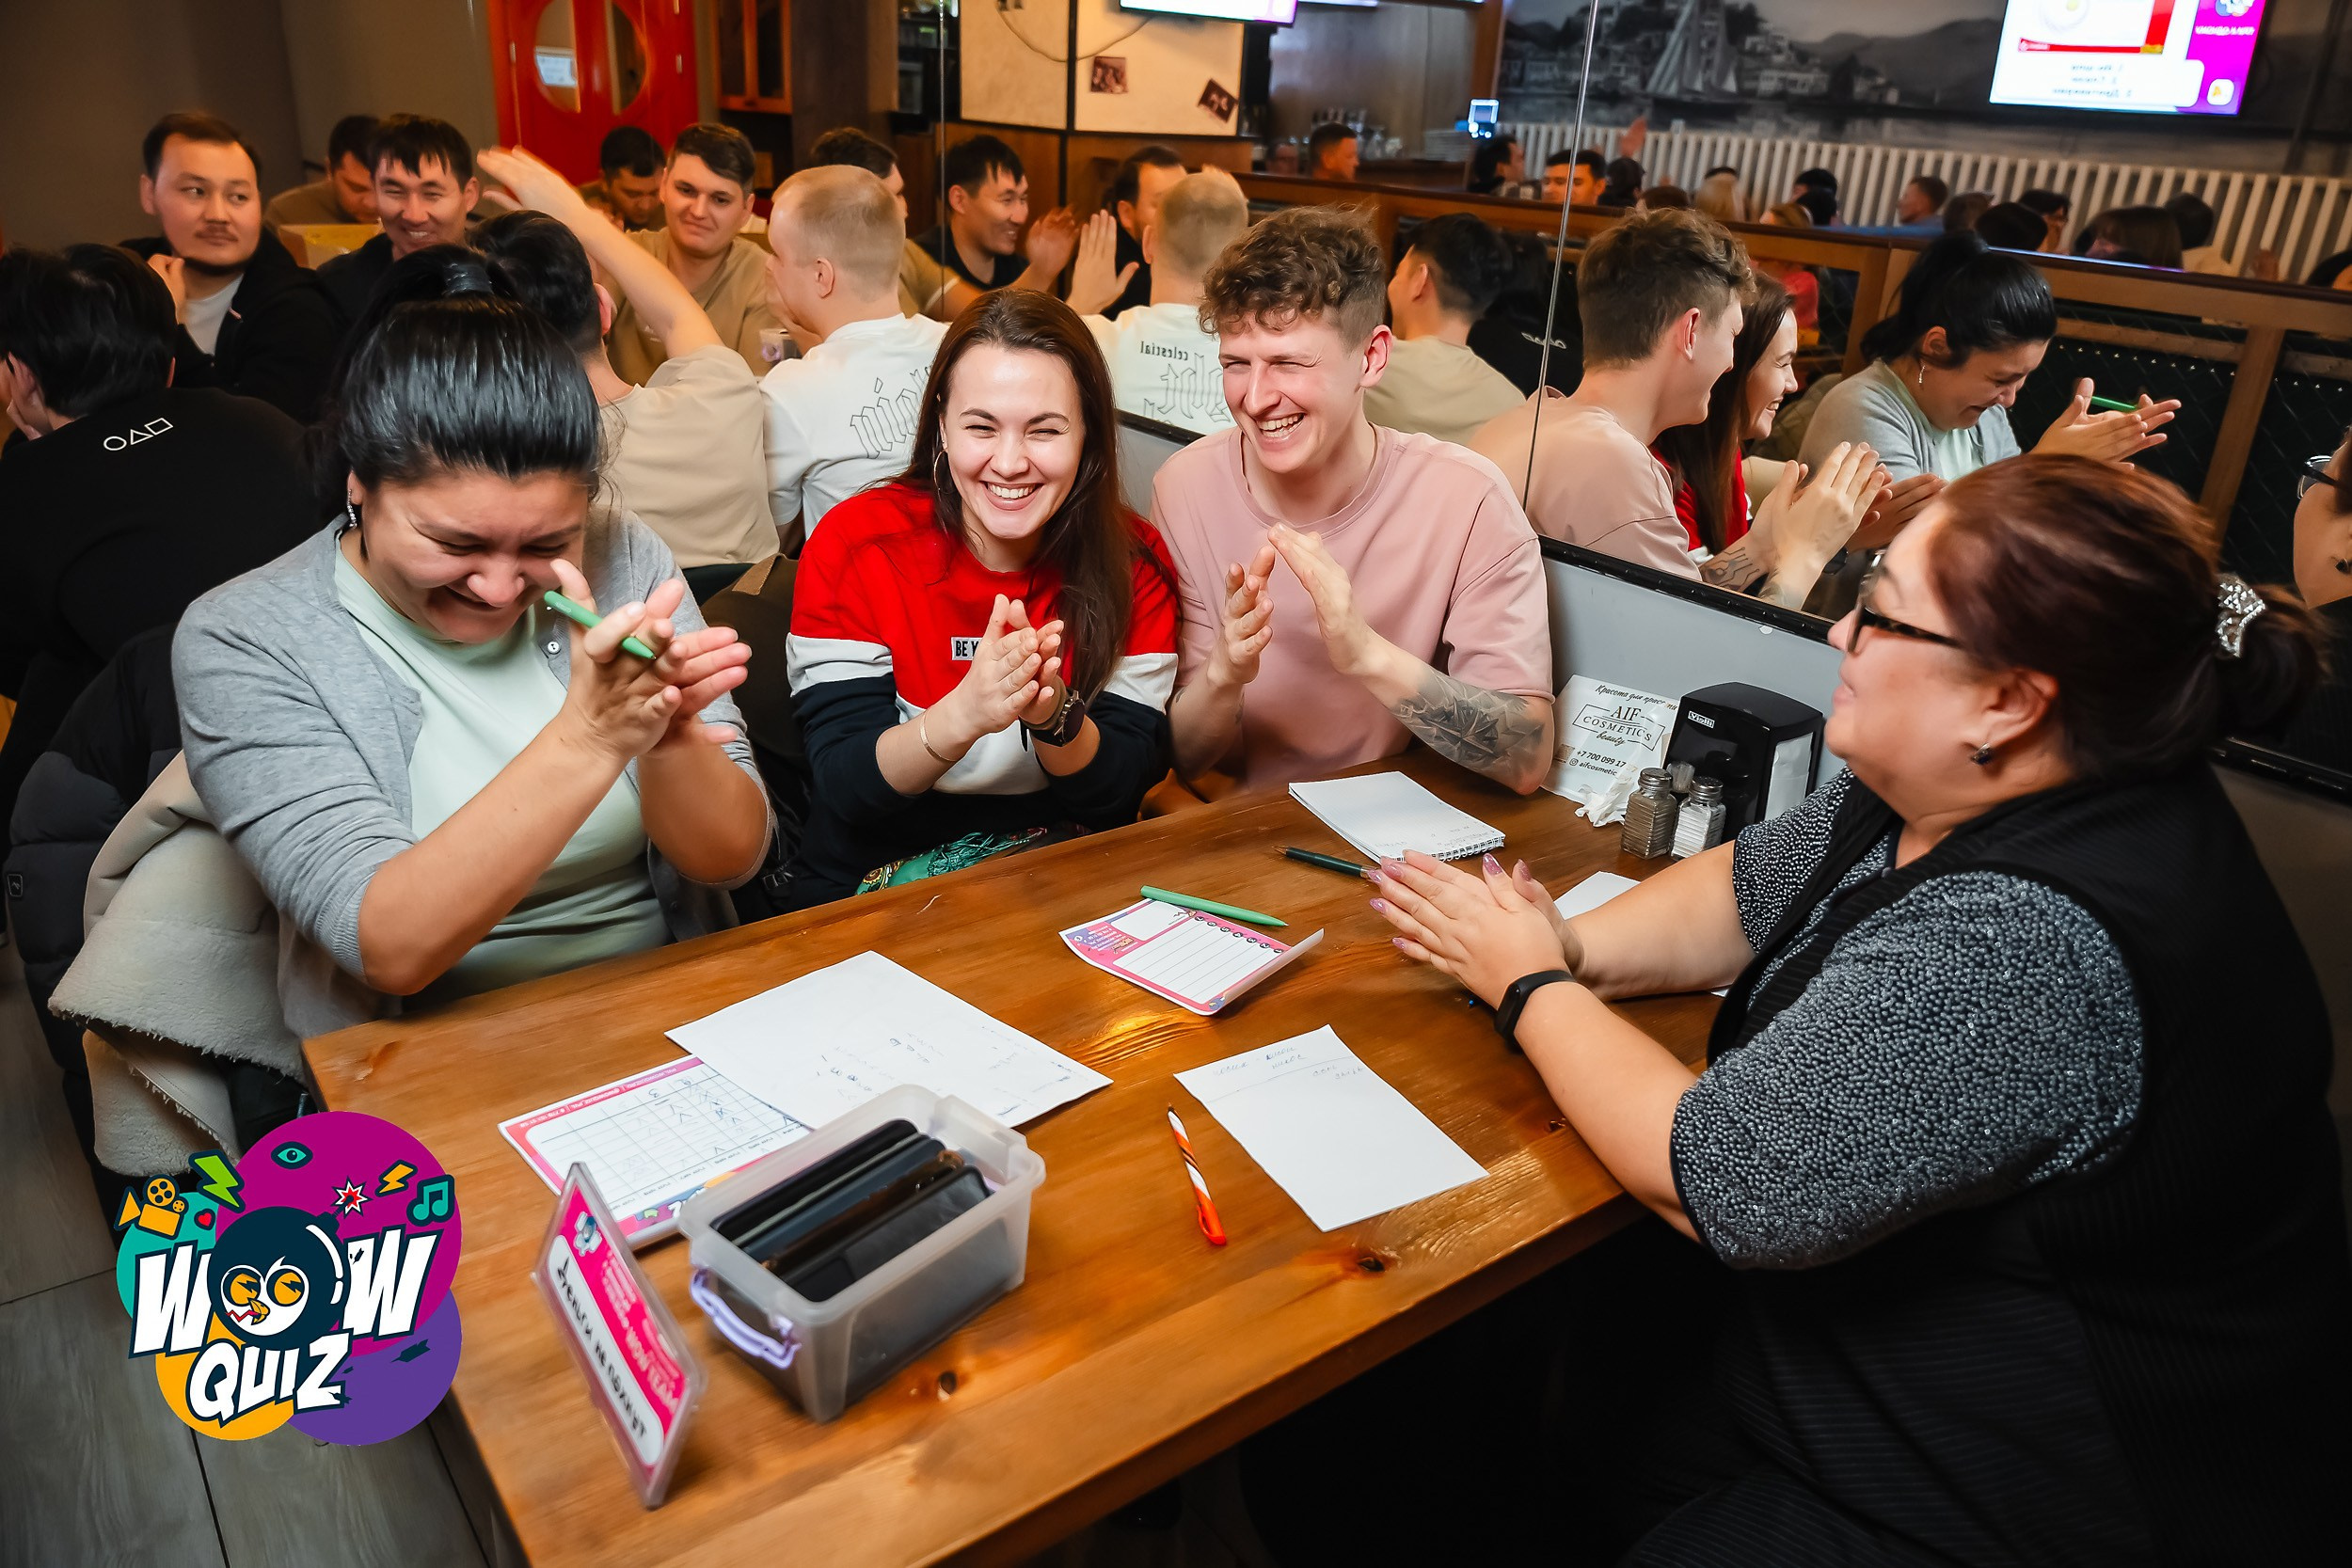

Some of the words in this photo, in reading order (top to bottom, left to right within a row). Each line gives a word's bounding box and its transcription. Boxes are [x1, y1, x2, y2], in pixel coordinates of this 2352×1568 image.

[955, 640, 968, 657] BE
[971, 641, 979, 657] Y
[1596, 685, 1629, 698] Красота
[1627, 693, 1643, 702] для
[1612, 706, 1642, 721] AIF
[1583, 716, 1652, 741] COSMETICS
[1597, 731, 1626, 746] beauty
[1587, 752, 1600, 761] 700
[1601, 756, 1615, 765] 099
[557, 1258, 593, 1340] Деньги
[595, 1339, 607, 1368] не
